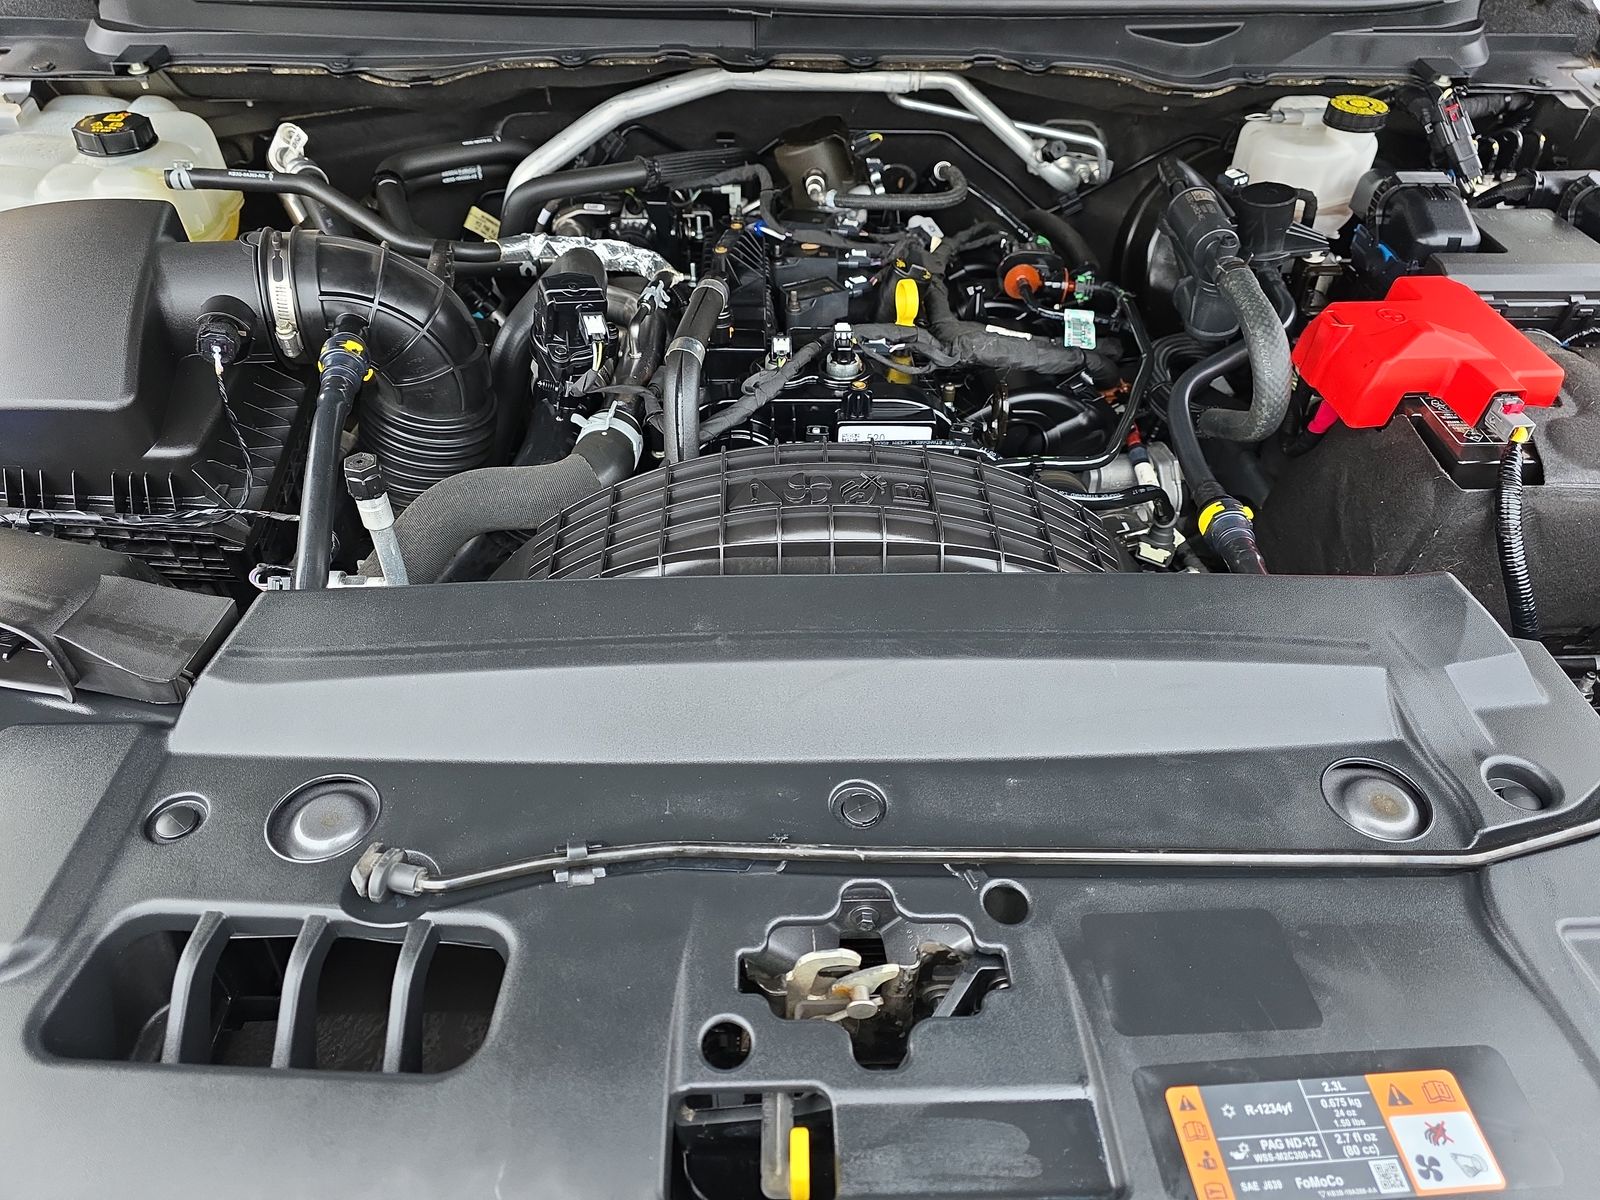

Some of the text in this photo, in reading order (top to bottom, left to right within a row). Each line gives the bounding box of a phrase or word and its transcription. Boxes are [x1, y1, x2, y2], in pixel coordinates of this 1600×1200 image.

[1321, 1080, 1346, 1092] 2.3L
[1244, 1102, 1293, 1116] R-1234yf
[1320, 1097, 1362, 1109] 0.675 kg
[1334, 1109, 1346, 1118] 24
[1259, 1136, 1318, 1151] PAG ND-12
[1334, 1132, 1378, 1144] 2.7 fl oz
[1342, 1144, 1380, 1158] (80 cc)
[1240, 1181, 1261, 1192] SAE
[1295, 1174, 1344, 1189] FoMoCo
